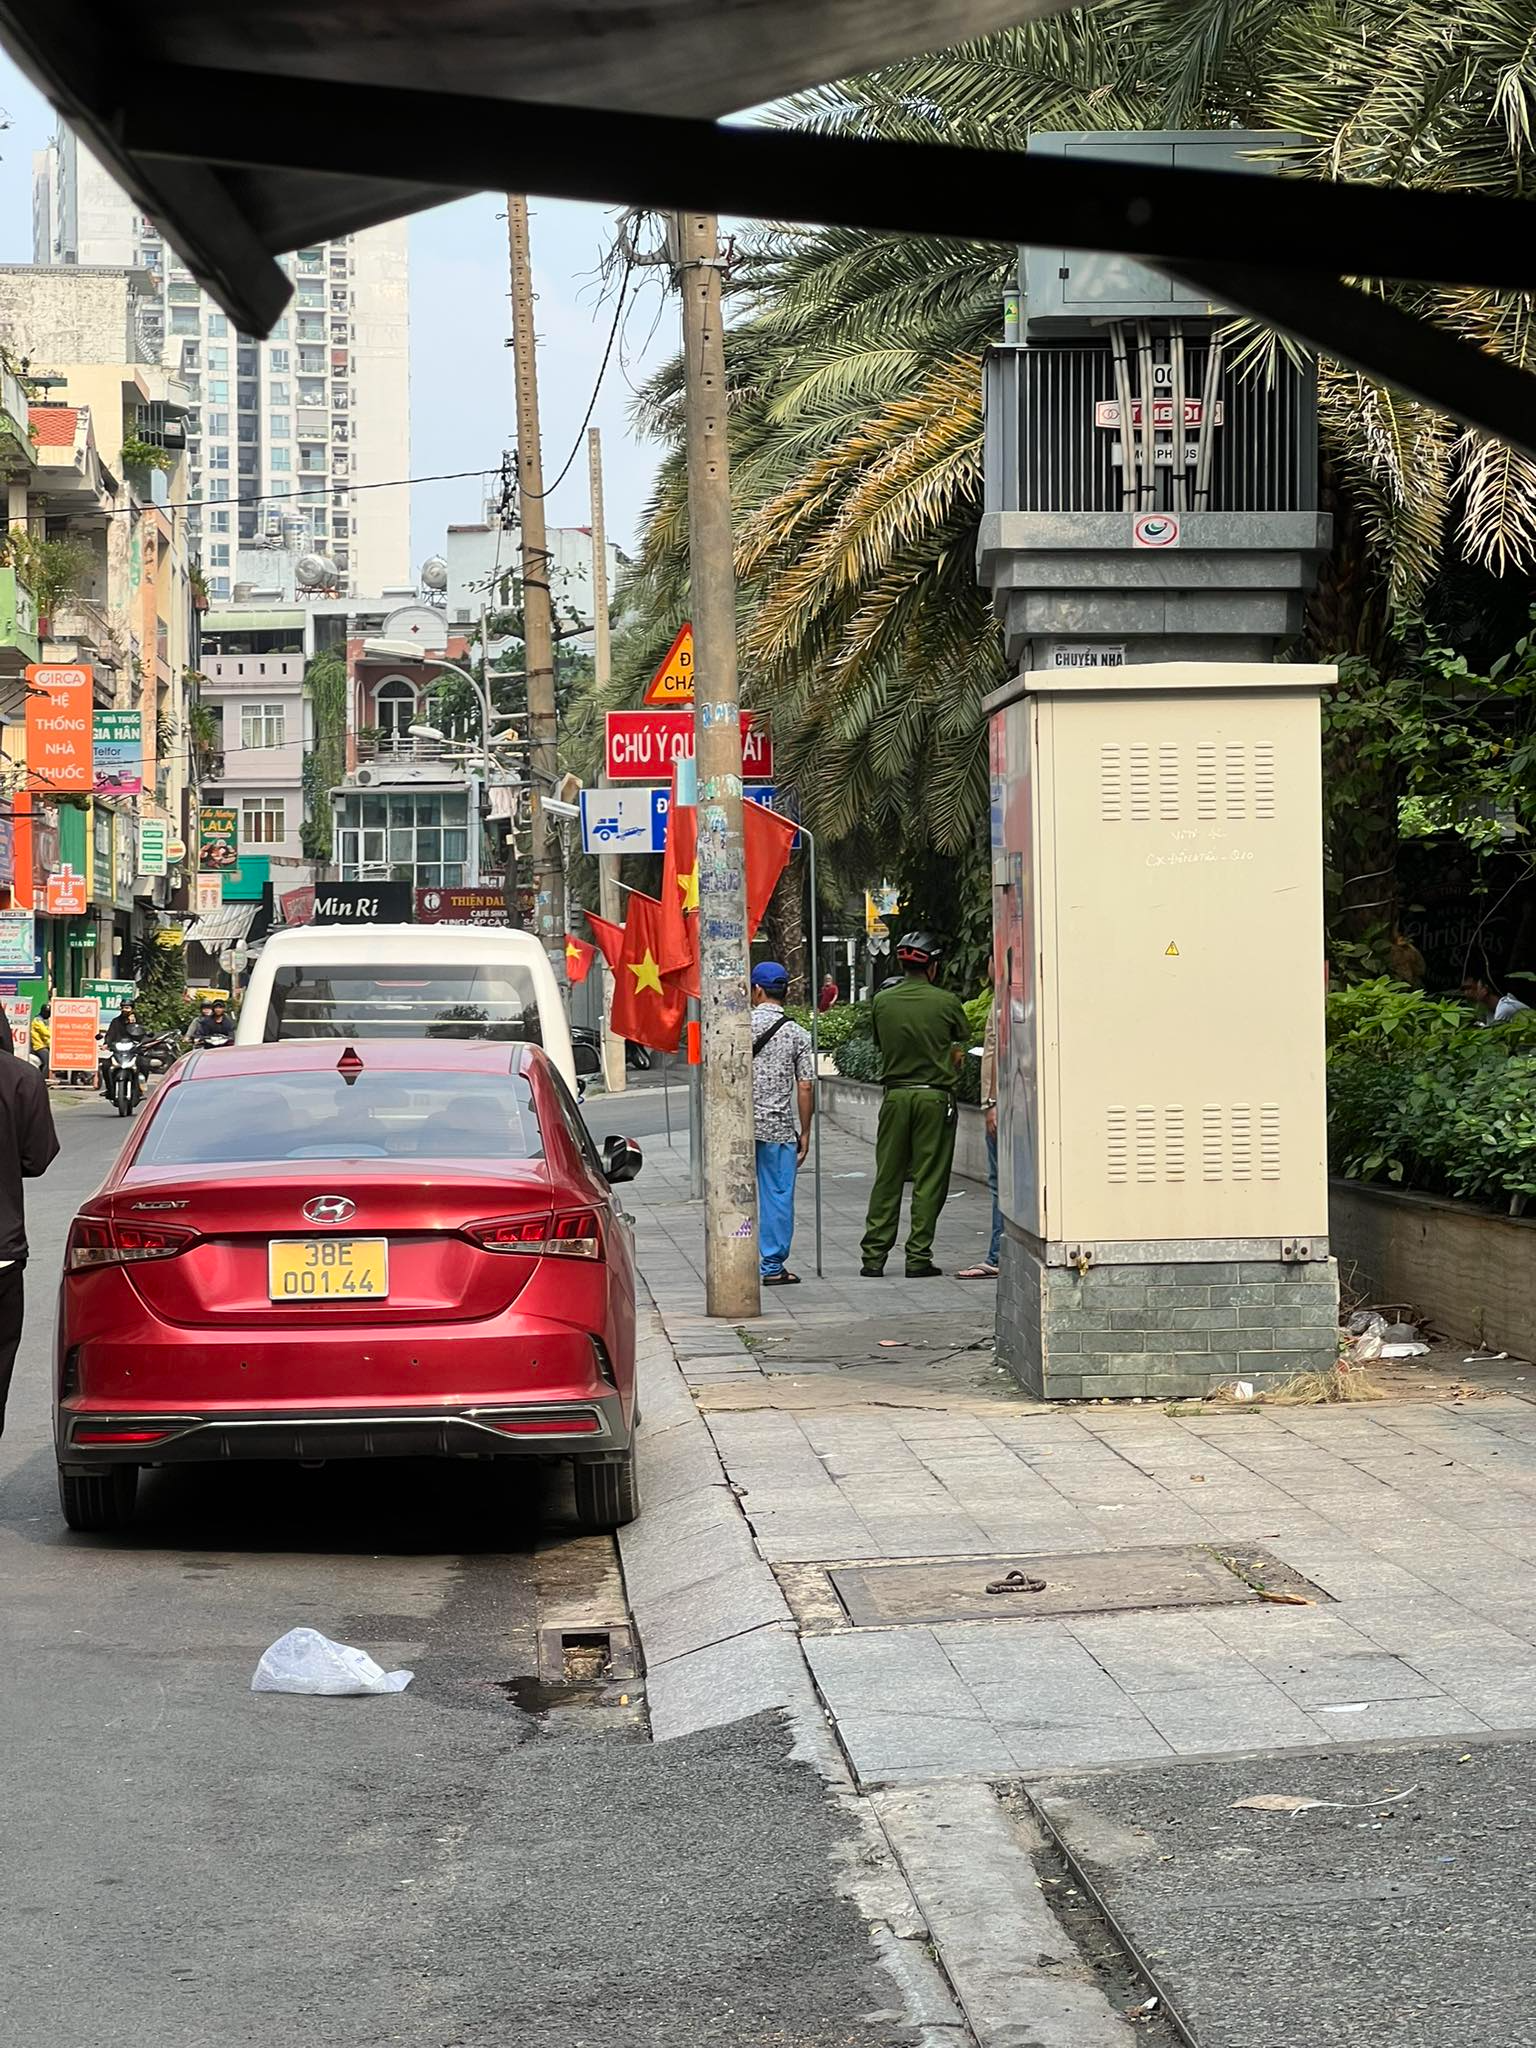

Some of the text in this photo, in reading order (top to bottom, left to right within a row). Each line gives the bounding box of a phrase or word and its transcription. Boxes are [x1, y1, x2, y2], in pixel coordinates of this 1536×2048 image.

[1055, 647, 1124, 667] CHUYỂN NHÀ
[51, 692, 70, 708] HỆ
[35, 715, 86, 731] THỐNG
[114, 725, 140, 740] HÂN
[45, 741, 75, 755] NHÀ
[612, 725, 651, 763] CHÚ
[655, 725, 669, 763] Ý
[37, 764, 85, 779] THUỐC
[200, 820, 235, 832] LALA
[311, 897, 353, 918] Min
[355, 897, 379, 917] Ri
[130, 1200, 190, 1210] ACCENT
[305, 1242, 354, 1267] 38E
[283, 1269, 374, 1295] 001.44
